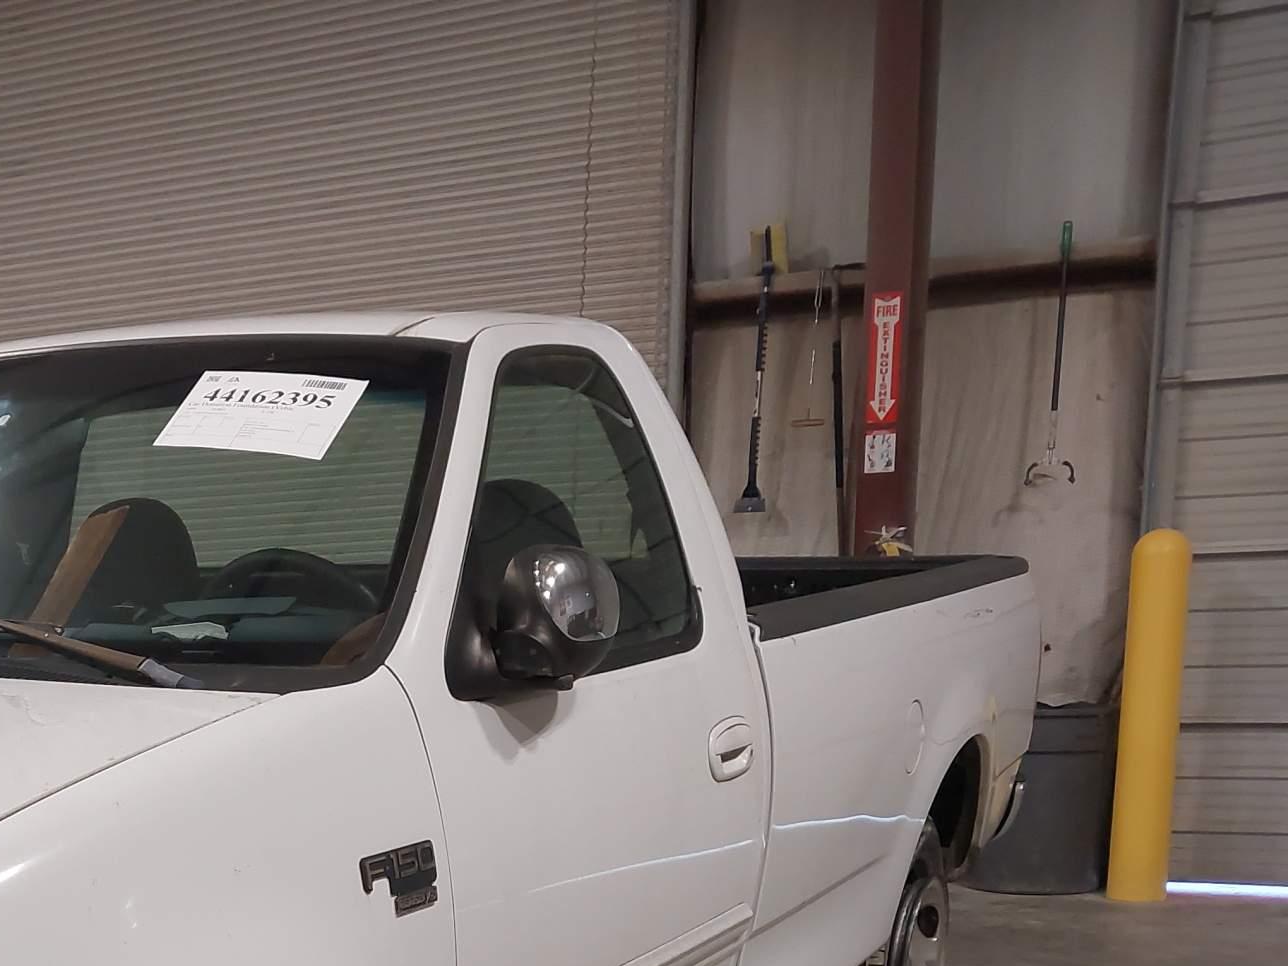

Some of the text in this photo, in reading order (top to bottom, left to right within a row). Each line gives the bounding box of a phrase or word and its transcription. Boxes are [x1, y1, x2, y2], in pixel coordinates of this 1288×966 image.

[876, 304, 899, 318] FIRE
[877, 321, 890, 413] EXTINGUISHER
[203, 387, 337, 409] 44162395
[360, 841, 435, 893] F150
